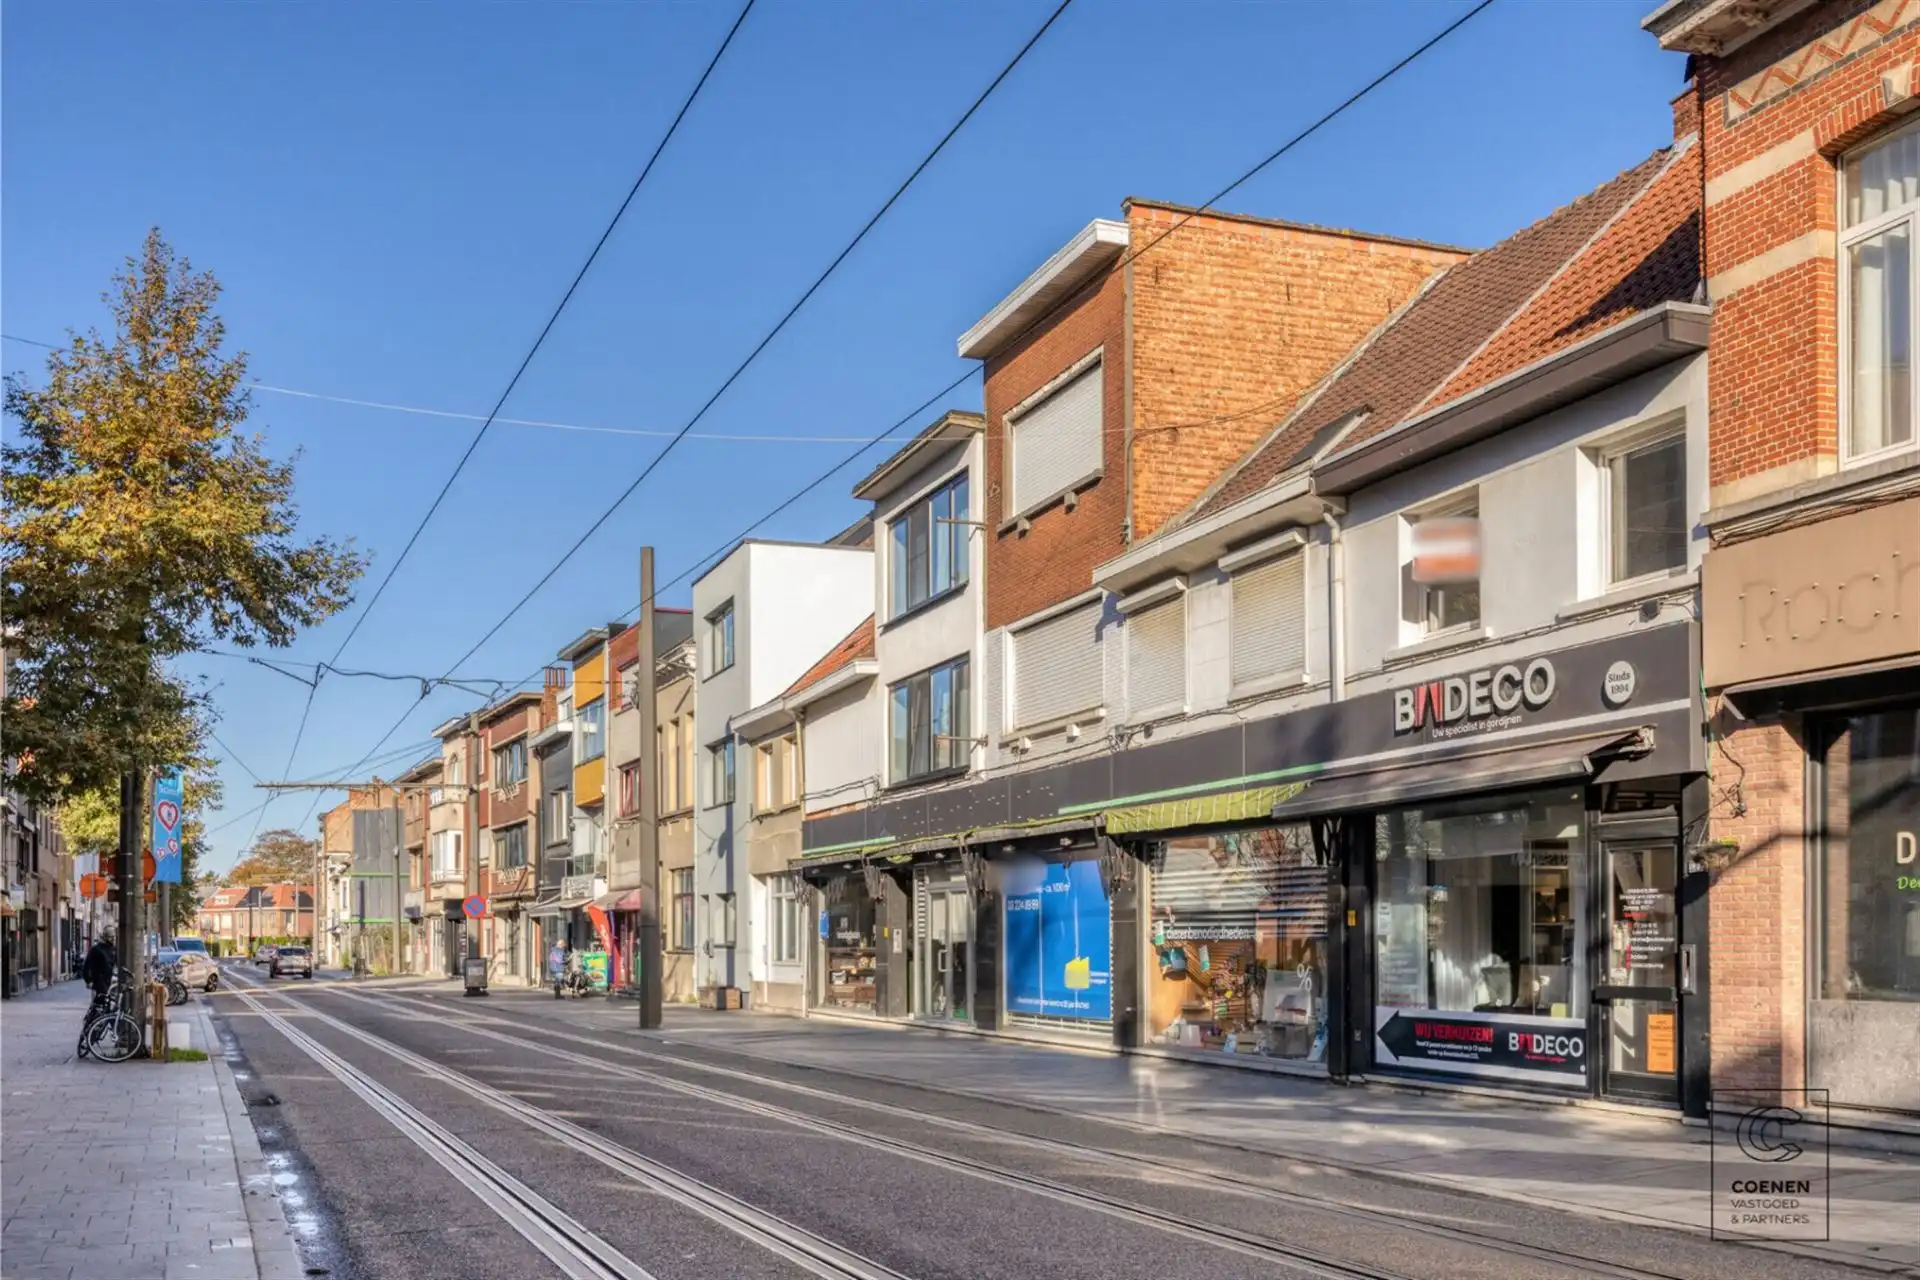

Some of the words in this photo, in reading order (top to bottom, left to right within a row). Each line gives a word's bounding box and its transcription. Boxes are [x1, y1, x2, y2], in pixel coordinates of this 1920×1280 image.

[1608, 671, 1631, 683] Sinds
[1432, 728, 1443, 738] Uw
[1445, 721, 1478, 737] specialist
[1479, 721, 1486, 729] in
[1486, 715, 1522, 731] gordijnen
[1896, 876, 1920, 890] De
[1414, 1021, 1431, 1039] WIJ
[1433, 1024, 1494, 1043] VERHUIZEN!
